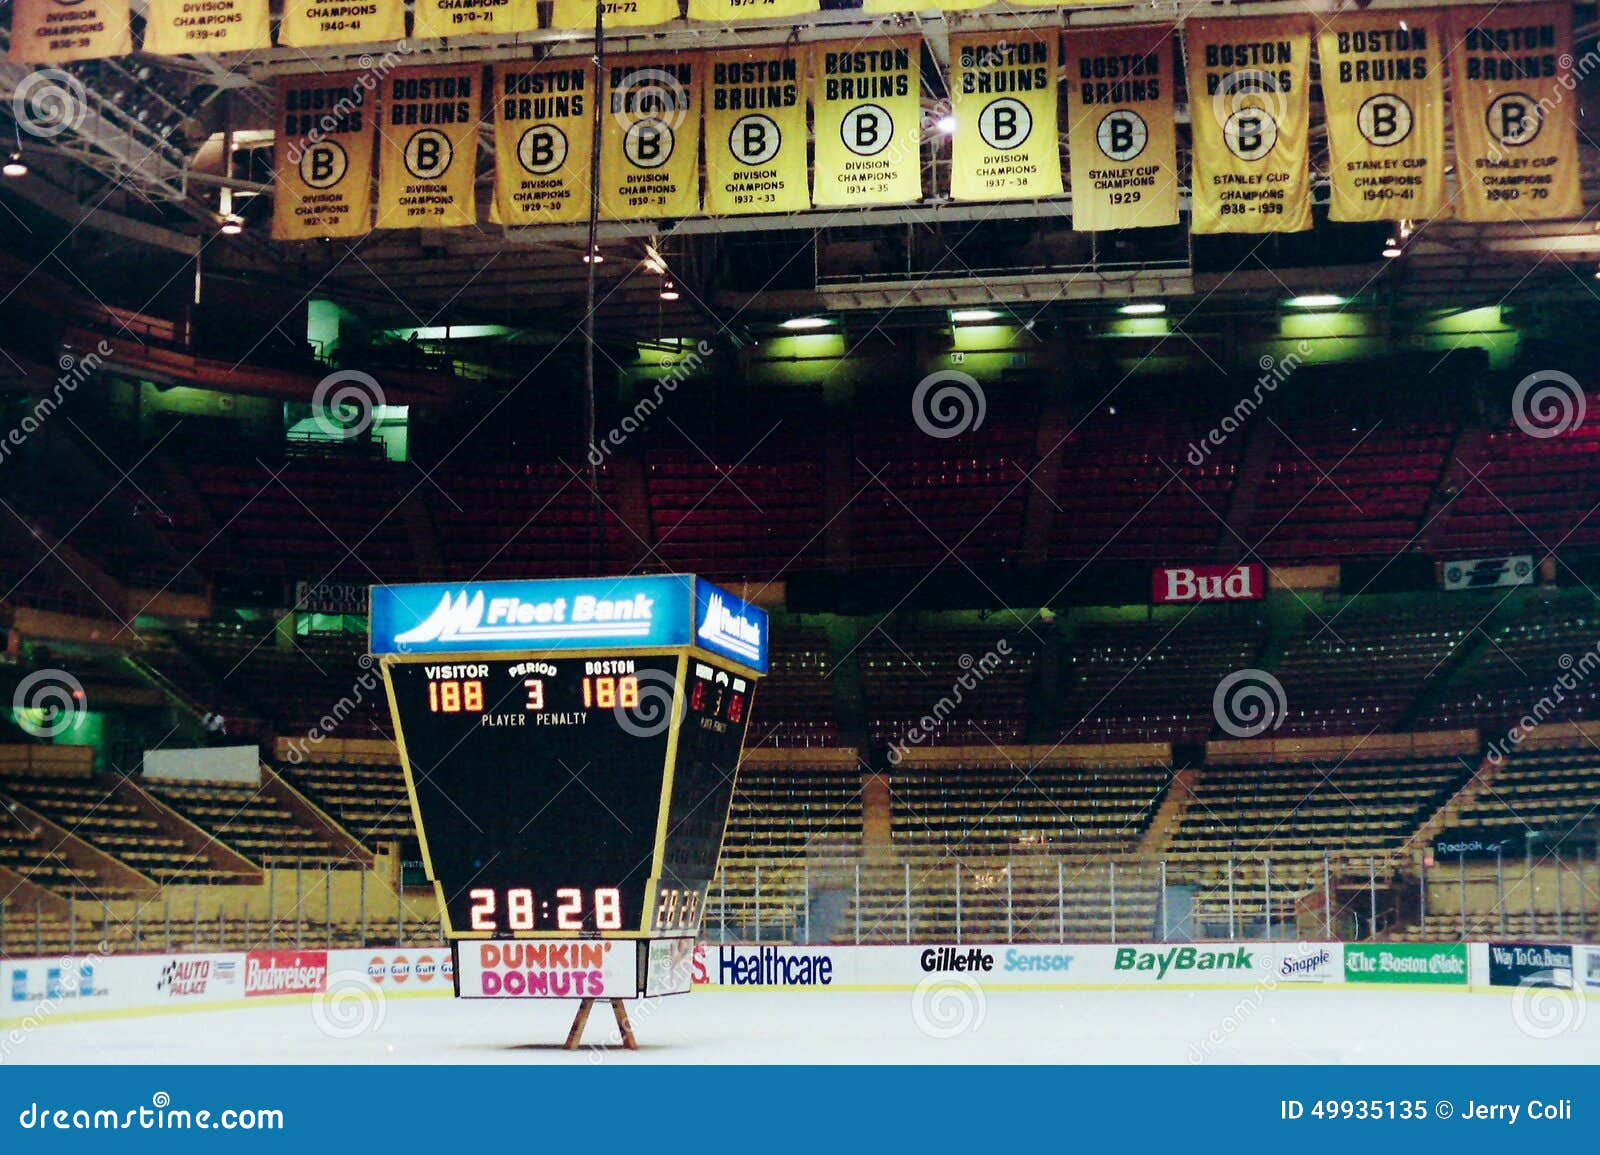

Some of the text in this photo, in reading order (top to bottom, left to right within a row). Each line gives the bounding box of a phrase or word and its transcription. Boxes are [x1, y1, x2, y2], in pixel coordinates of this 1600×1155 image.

[173, 12, 242, 27] CHAMPIONS
[183, 2, 233, 13] DIVISION
[306, 4, 377, 18] CHAMPIONS
[453, 12, 493, 23] 1970-71
[320, 20, 361, 31] 1940-41
[1338, 28, 1427, 54] BOSTON
[1465, 25, 1555, 52] BOSTON
[825, 48, 909, 75] BOSTON
[961, 41, 1047, 68] BOSTON
[1079, 54, 1159, 79] BOSTON
[1206, 41, 1291, 68] BOSTON
[610, 64, 692, 88] BOSTON
[714, 58, 796, 85] BOSTON
[963, 67, 1048, 94] BRUINS
[1340, 57, 1428, 83] BRUINS
[1467, 55, 1557, 81] BRUINS
[393, 76, 471, 99] BOSTON
[504, 69, 585, 95] BOSTON
[826, 75, 909, 101] BRUINS
[1082, 79, 1160, 105] BRUINS
[1207, 70, 1291, 96] BRUINS
[504, 95, 584, 120] BRUINS
[610, 89, 690, 114] BRUINS
[714, 84, 796, 110] BRUINS
[392, 102, 470, 125] BRUINS
[994, 107, 1017, 140] B
[1372, 103, 1397, 137] B
[1502, 102, 1526, 137] B
[743, 123, 766, 156] B
[856, 113, 878, 146] B
[1111, 119, 1133, 152] B
[1239, 118, 1261, 151] B
[417, 138, 440, 170] B
[532, 133, 554, 166] B
[638, 127, 660, 159] B
[312, 149, 333, 180] B
[845, 160, 890, 171] DIVISION
[976, 165, 1037, 176] CHAMPIONS
[983, 154, 1029, 165] DIVISION
[1347, 158, 1427, 171] STANLEY CUP
[521, 179, 563, 189] DIVISION
[627, 174, 669, 183] DIVISION
[733, 170, 777, 181] DIVISION
[837, 171, 898, 182] CHAMPIONS
[1089, 166, 1160, 179] STANLEY CUP
[1095, 177, 1155, 189] CHAMPIONS
[1213, 173, 1290, 185] STANLEY CUP
[1354, 175, 1423, 188] CHAMPIONS
[513, 190, 571, 201] CHAMPIONS
[619, 185, 676, 195] CHAMPIONS
[725, 181, 785, 192] CHAMPIONS
[1109, 192, 1141, 205] 1929
[1220, 190, 1284, 201] CHAMPIONS
[1363, 188, 1414, 201] 1940-41
[1164, 566, 1252, 600] Bud
[487, 593, 655, 625] Fleet Bank
[424, 664, 489, 680] VISITOR
[508, 662, 557, 678] PERIOD
[585, 660, 635, 675] BOSTON
[428, 681, 484, 712] 188
[524, 679, 544, 709] 3
[581, 676, 639, 708] 188
[482, 712, 588, 727] PLAYER PENALTY
[1437, 840, 1482, 854] Reebok
[480, 942, 612, 968] DUNKIN'
[719, 945, 833, 985] Healthcare
[920, 948, 1074, 973] Gillette Sensor
[1114, 946, 1254, 980] BayBank
[1281, 949, 1330, 975] Snapple
[1347, 952, 1466, 974] The Boston Globe
[1493, 947, 1513, 970] Way
[1513, 948, 1527, 966] To
[175, 960, 210, 981] AUTO
[245, 957, 326, 991] Budweiser
[367, 966, 387, 975] Gulf
[391, 965, 411, 975] Gulf
[415, 964, 436, 974] Gulf
[169, 980, 207, 997] PALACE
[480, 970, 605, 996] DONUTS
